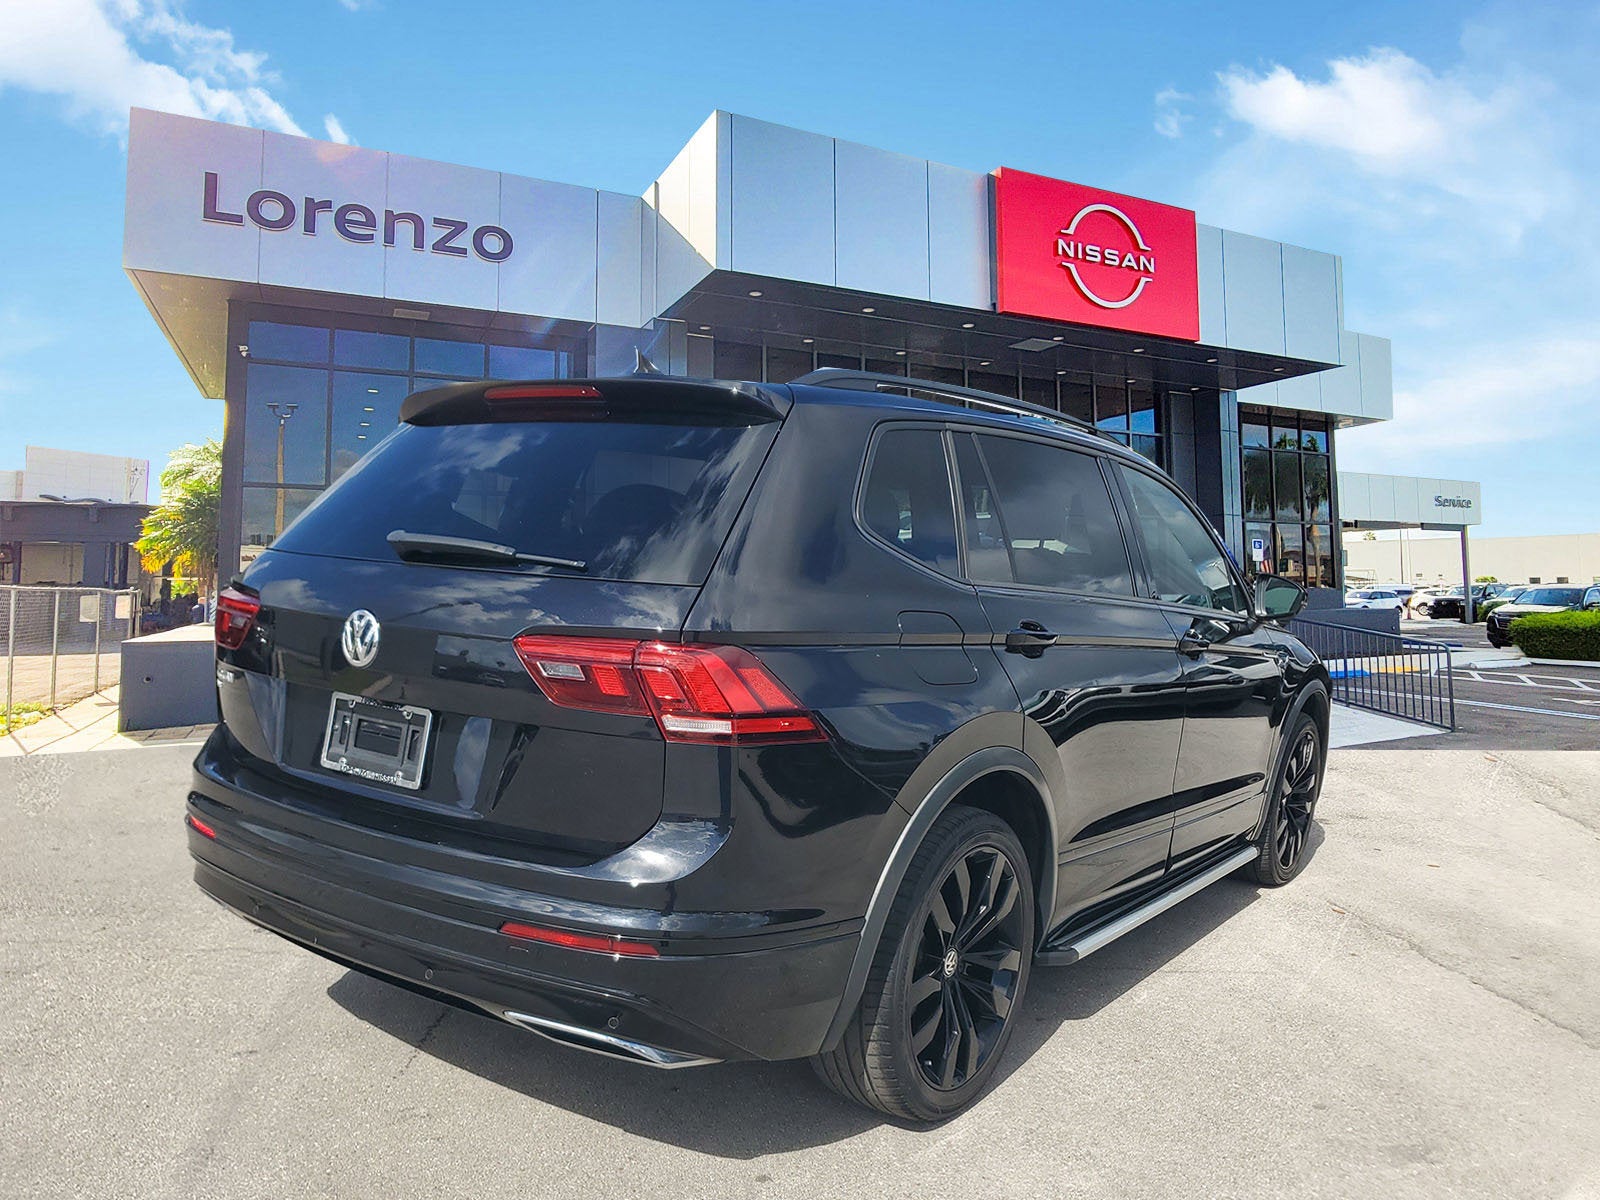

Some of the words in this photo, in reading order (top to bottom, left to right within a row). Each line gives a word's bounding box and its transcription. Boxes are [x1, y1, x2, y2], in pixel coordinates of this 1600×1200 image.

[203, 171, 514, 262] Lorenzo
[1057, 238, 1155, 273] NISSAN
[1434, 495, 1472, 509] Service
